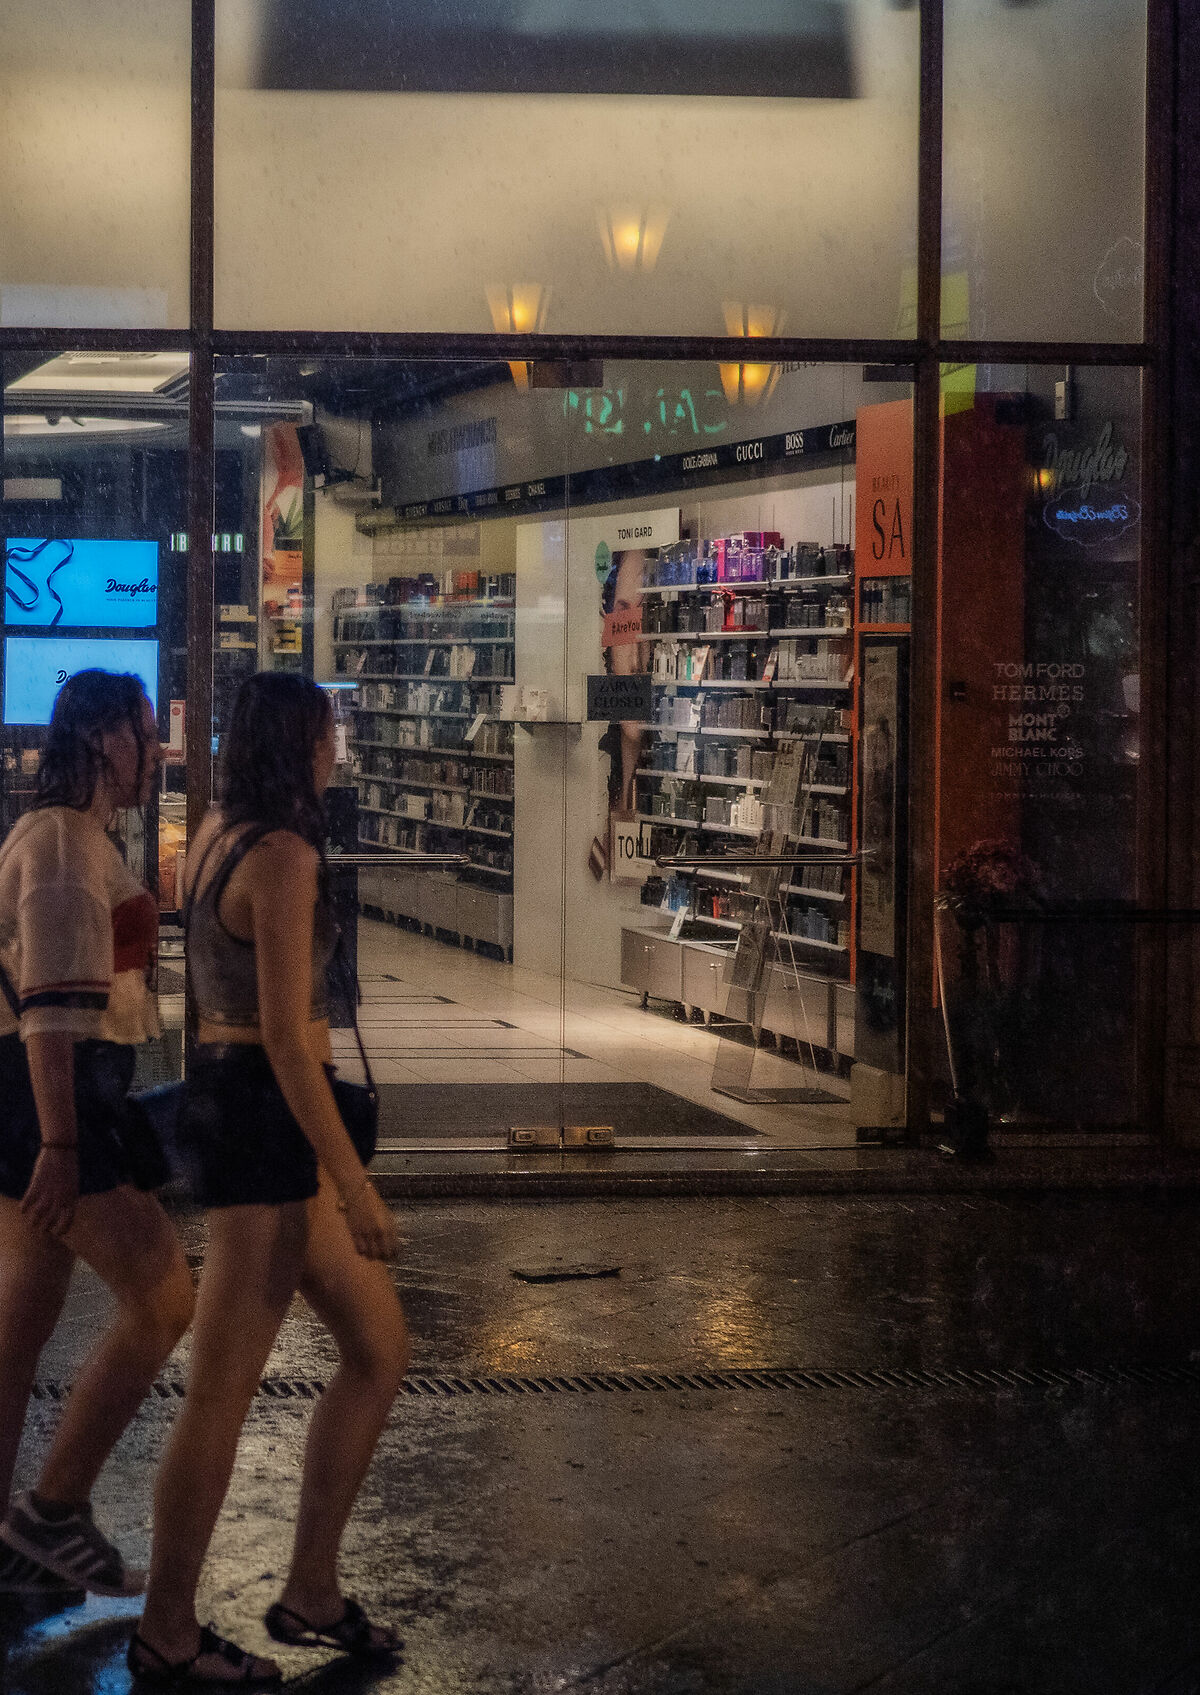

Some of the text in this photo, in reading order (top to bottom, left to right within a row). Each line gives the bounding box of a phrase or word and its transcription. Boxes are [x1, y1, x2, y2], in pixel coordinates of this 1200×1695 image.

[785, 432, 804, 450] BOSS
[829, 425, 855, 448] Cartier
[736, 442, 764, 462] GUCCI
[618, 526, 652, 540] TONI GARD
[992, 662, 1086, 679] TOM FORD
[1008, 713, 1057, 727] MONT
[1008, 728, 1057, 742] BLANC
[990, 747, 1084, 759] MICHAEL KORS
